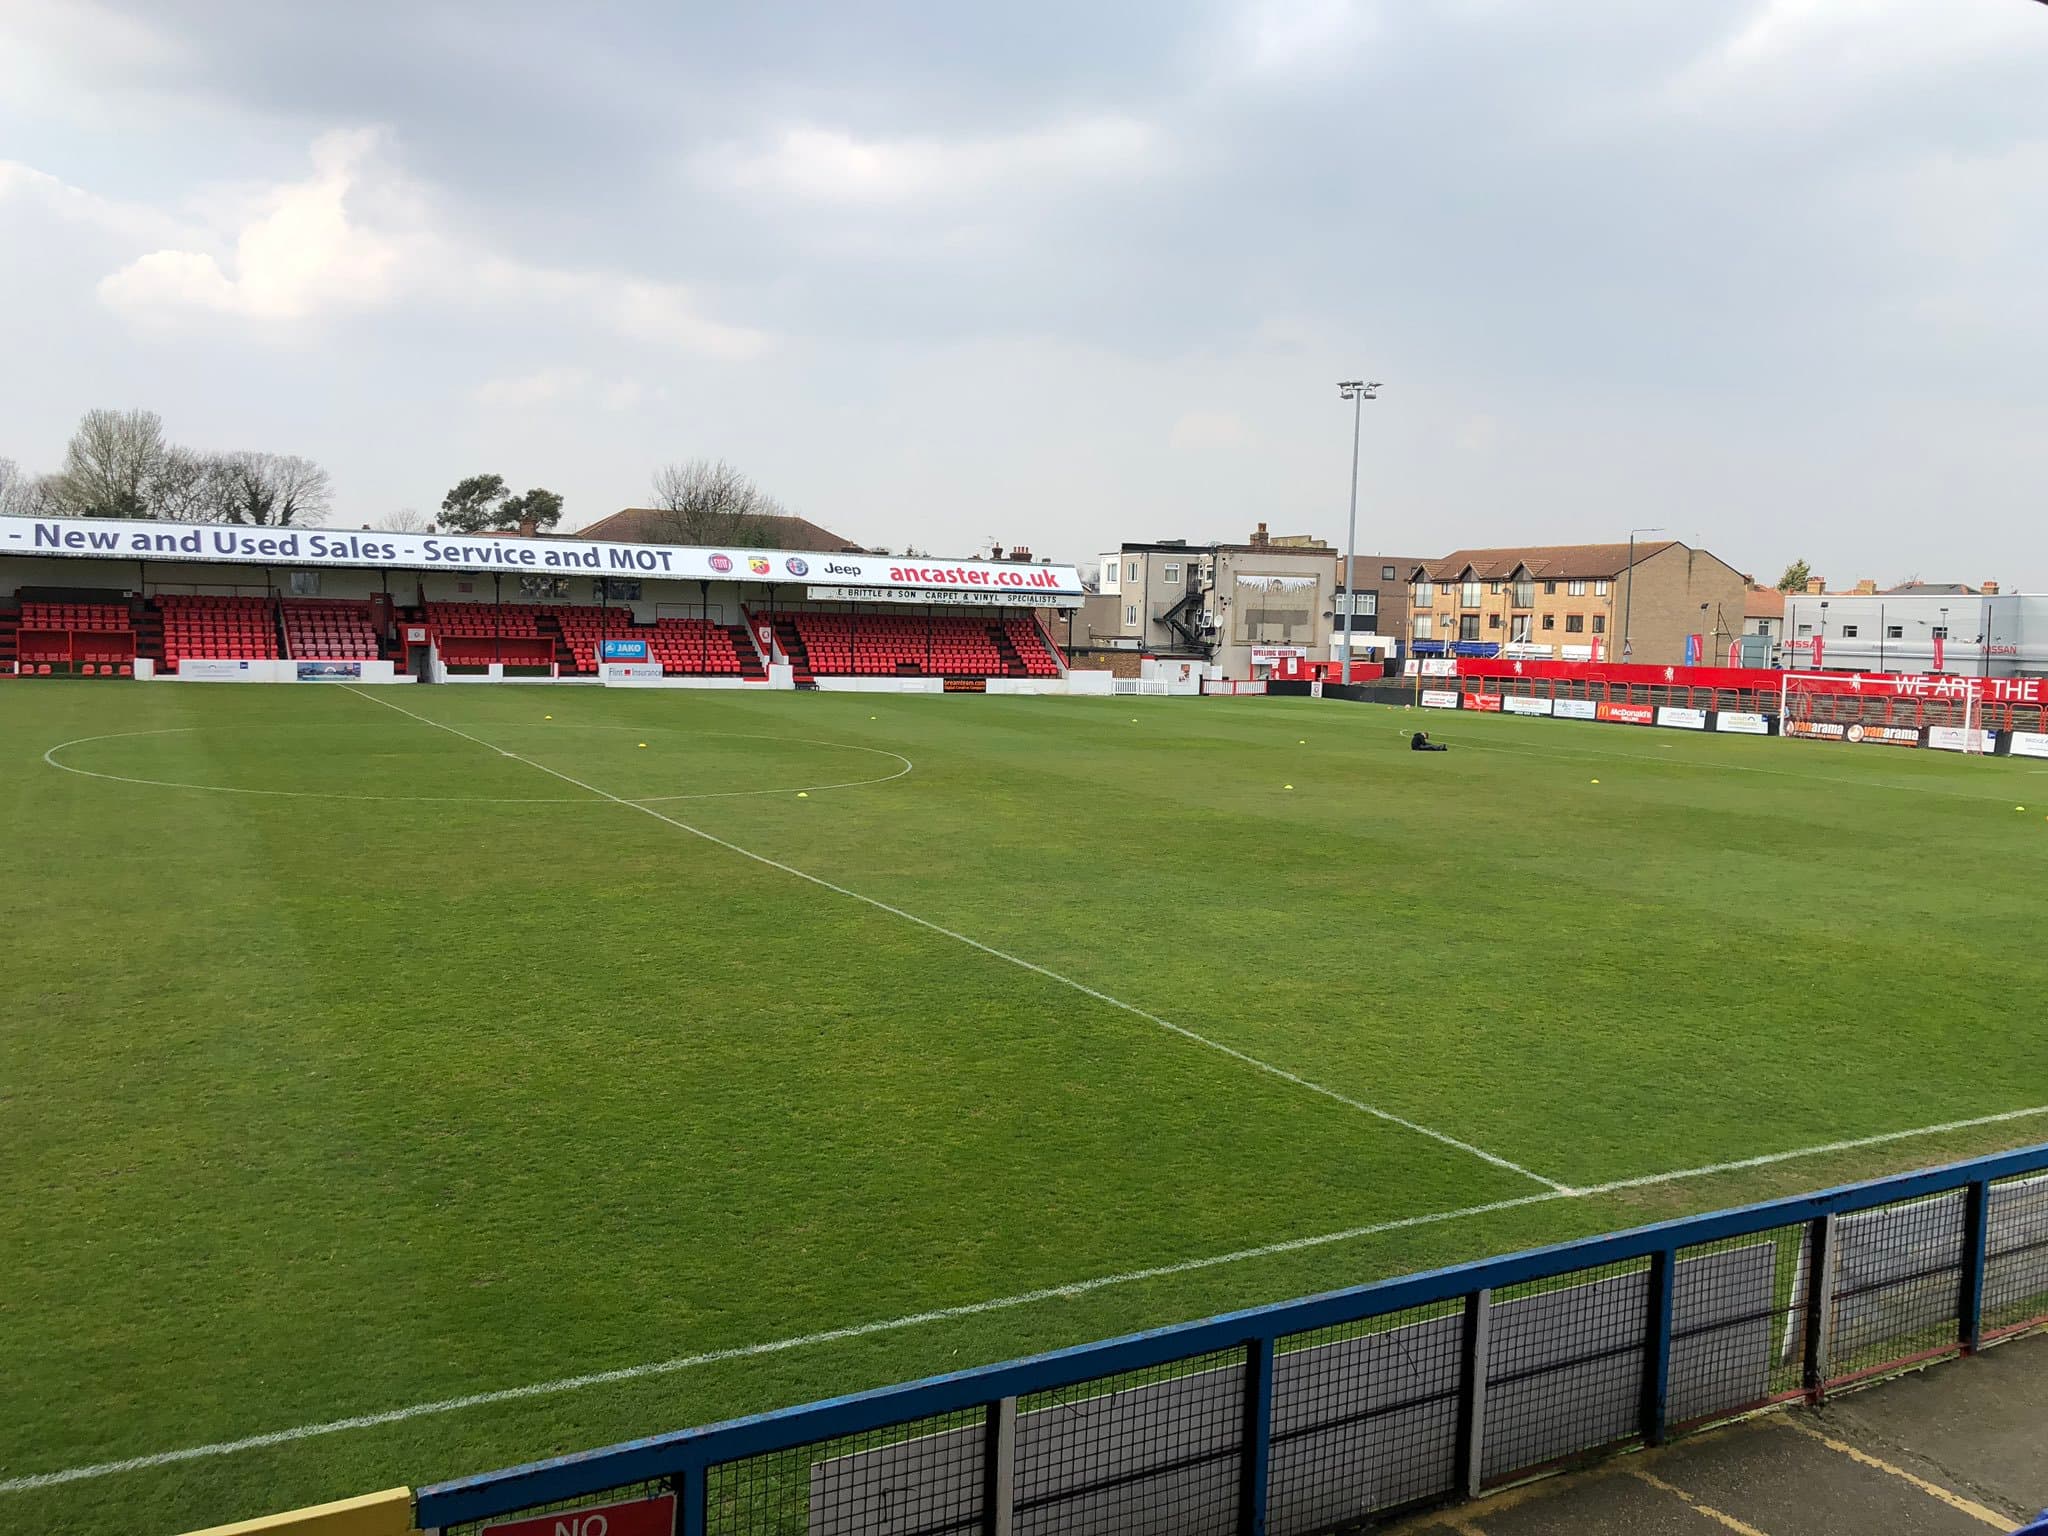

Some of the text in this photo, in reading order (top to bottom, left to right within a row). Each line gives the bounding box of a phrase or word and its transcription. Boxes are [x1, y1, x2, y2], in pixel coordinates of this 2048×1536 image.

[34, 523, 120, 549] New
[131, 530, 200, 553] and
[213, 531, 300, 556] Used
[310, 535, 396, 559] Sales
[423, 540, 536, 565] Service
[544, 546, 601, 568] and
[609, 548, 673, 571] MOT
[824, 562, 861, 577] Jeep
[890, 567, 1060, 588] ancaster.co.uk
[848, 589, 882, 598] BRITTLE
[887, 590, 893, 598] &
[898, 590, 916, 598] SON
[925, 591, 958, 600] CARPET
[974, 593, 999, 602] VINYL
[1007, 594, 1057, 603] SPECIALISTS
[617, 644, 641, 653] JAKO
[1784, 640, 1826, 649] NSSA
[608, 667, 662, 677] Flint Insurance
[1895, 676, 2040, 701] WE ARE THE
[1610, 708, 1652, 718] McDonald's
[1794, 721, 1845, 735] vanarama
[1864, 726, 1919, 740] vanarama
[556, 1515, 608, 1536] NO
